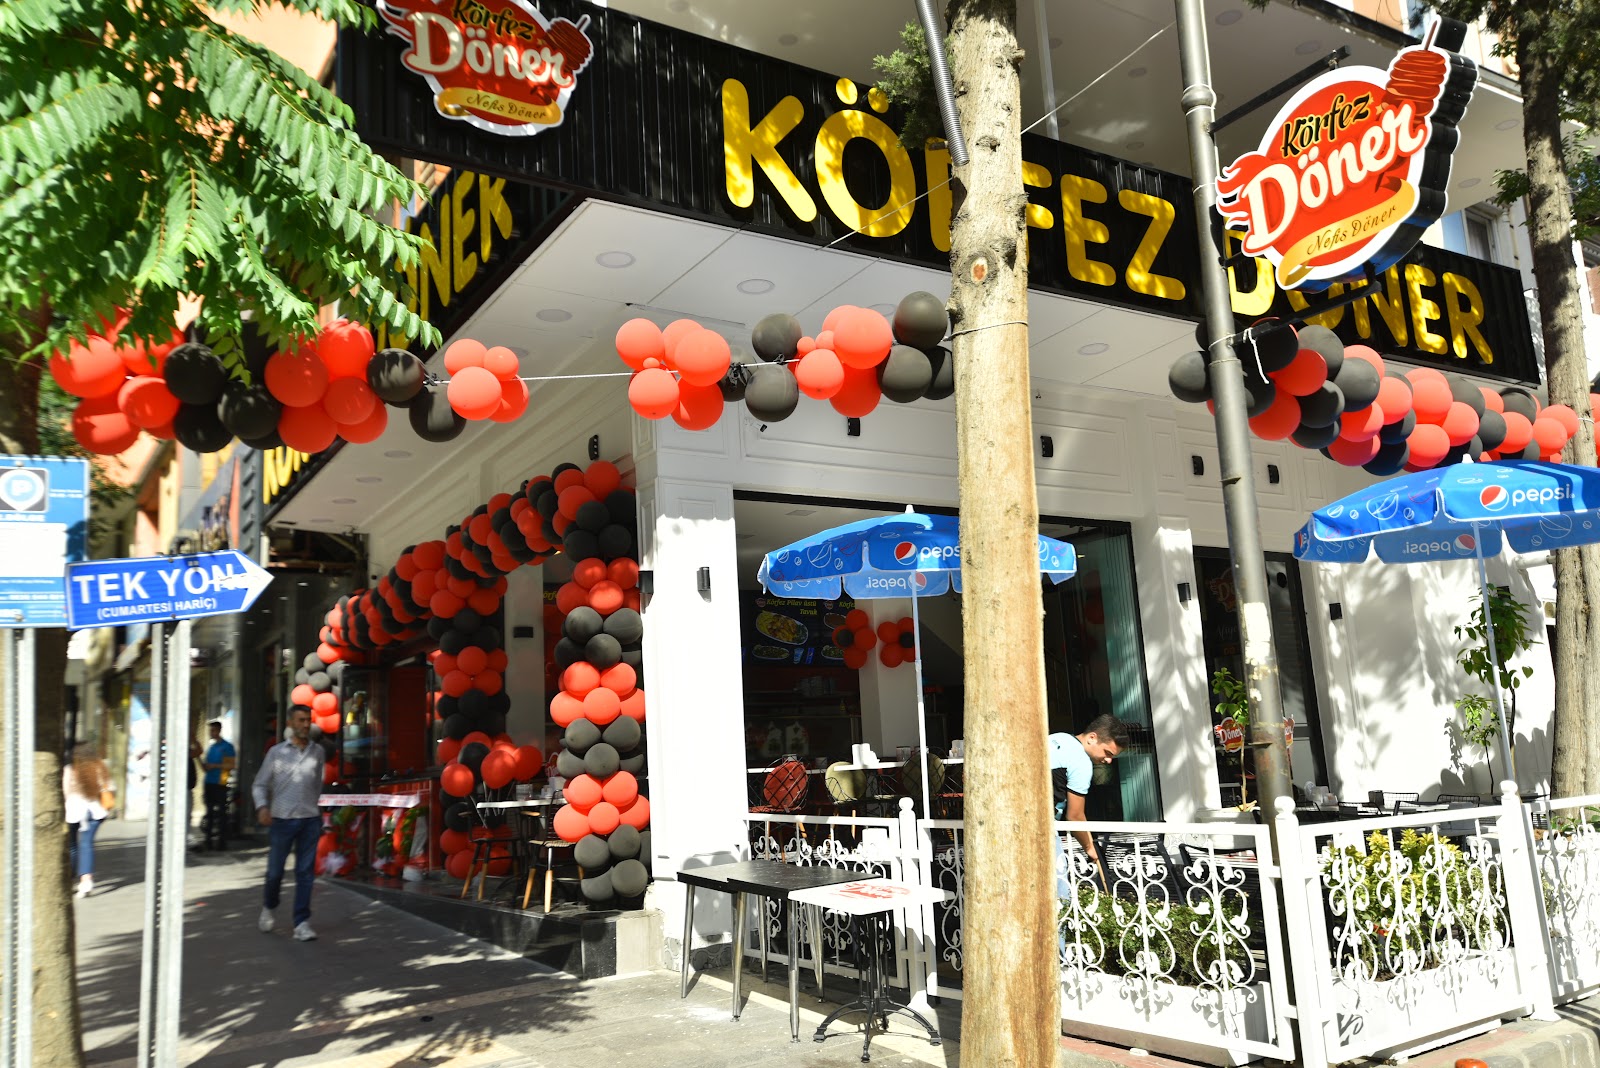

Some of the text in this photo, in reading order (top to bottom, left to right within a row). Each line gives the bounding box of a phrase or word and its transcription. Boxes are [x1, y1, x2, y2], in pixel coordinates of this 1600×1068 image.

[452, 0, 534, 40] Körfez
[406, 12, 573, 87] Döner
[466, 93, 547, 120] Nefis Döner
[1282, 94, 1372, 158] Körfez
[1242, 103, 1425, 250] Döner
[1306, 204, 1397, 255] Nefis Döner
[1512, 484, 1571, 507] pepsi
[921, 545, 961, 562] peps
[73, 571, 150, 604] TEK
[97, 597, 217, 620] (CUMARTESİ HARİÇ)
